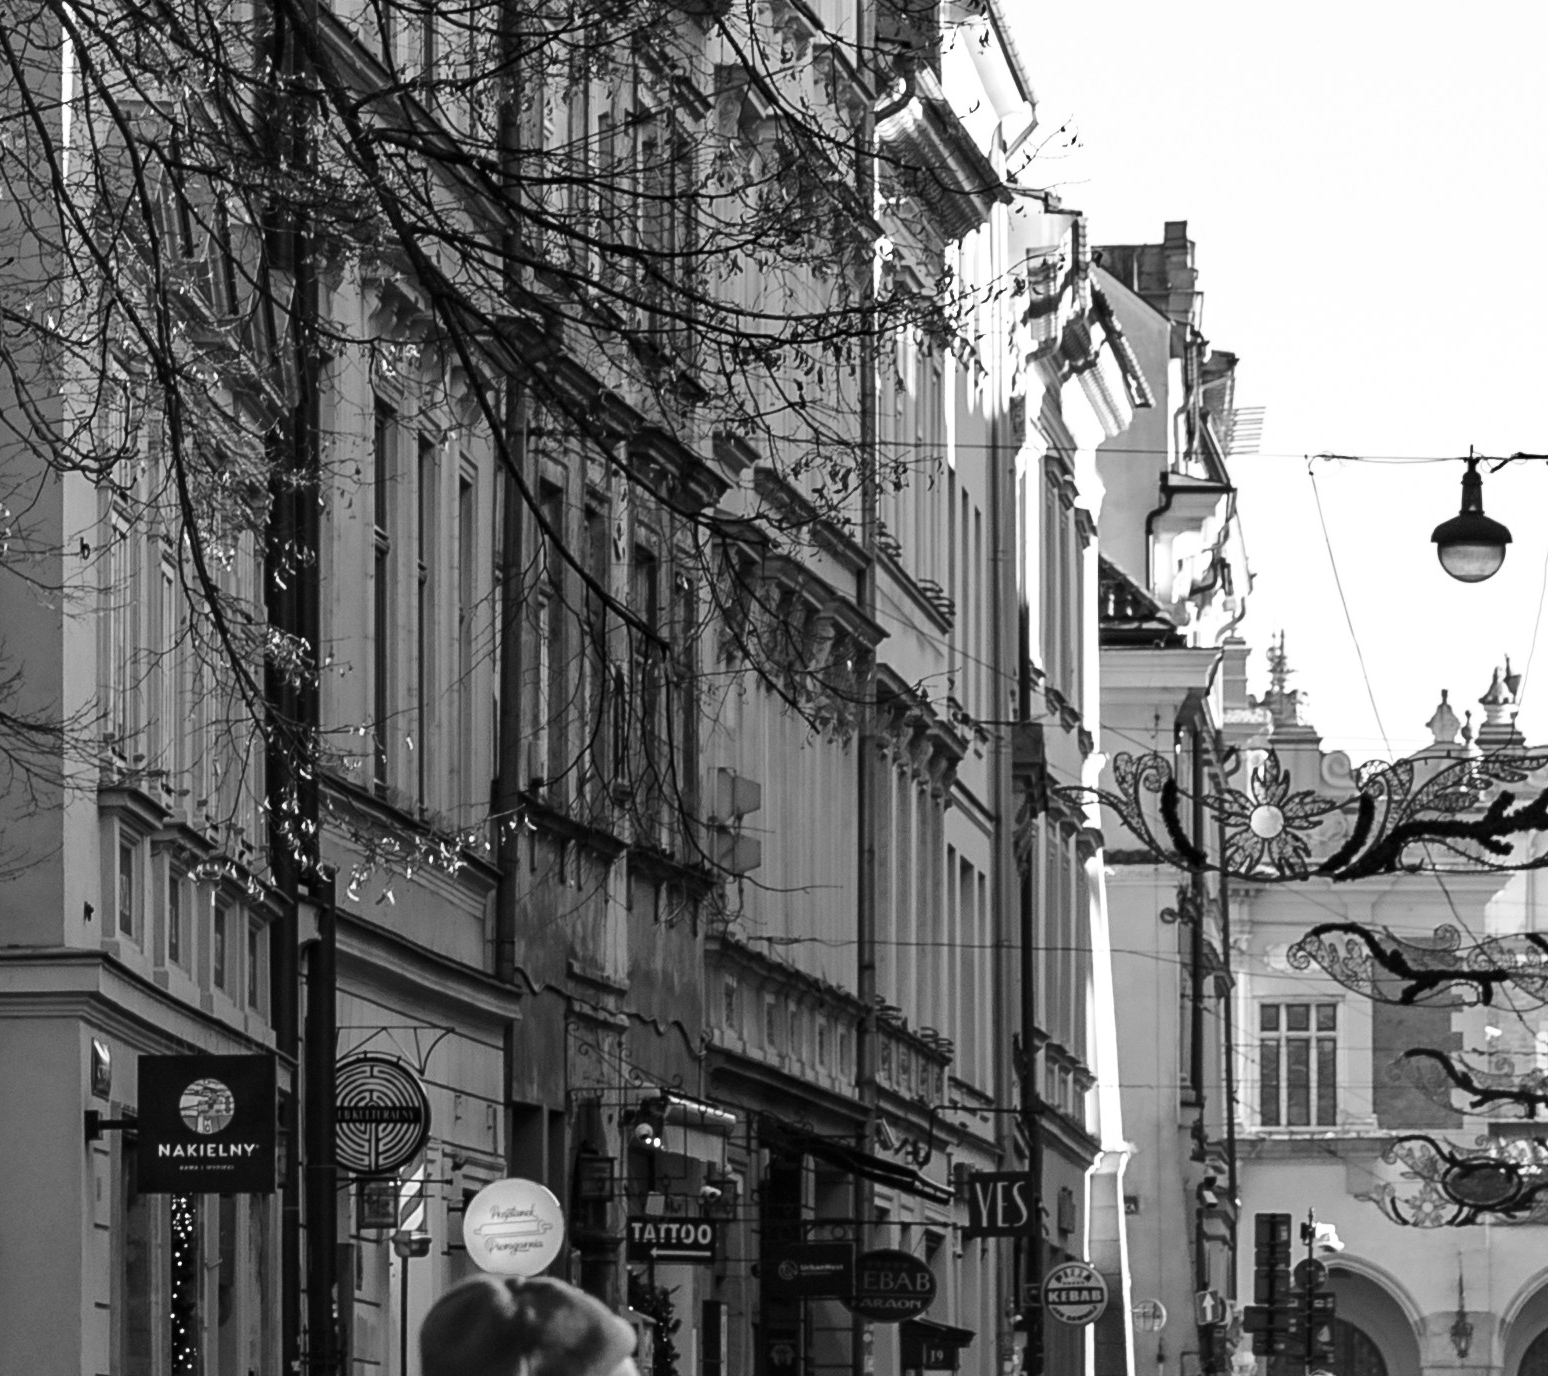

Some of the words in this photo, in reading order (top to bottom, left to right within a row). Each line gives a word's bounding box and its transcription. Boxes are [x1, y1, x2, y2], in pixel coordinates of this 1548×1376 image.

[158, 1144, 256, 1157] NAKIELNY
[975, 1181, 1028, 1227] YES
[631, 1222, 712, 1244] TATTOO
[863, 1271, 930, 1291] EBAB
[1054, 1268, 1092, 1284] PIZZA
[1048, 1289, 1102, 1302] KEBAB
[930, 1350, 944, 1362] 19
